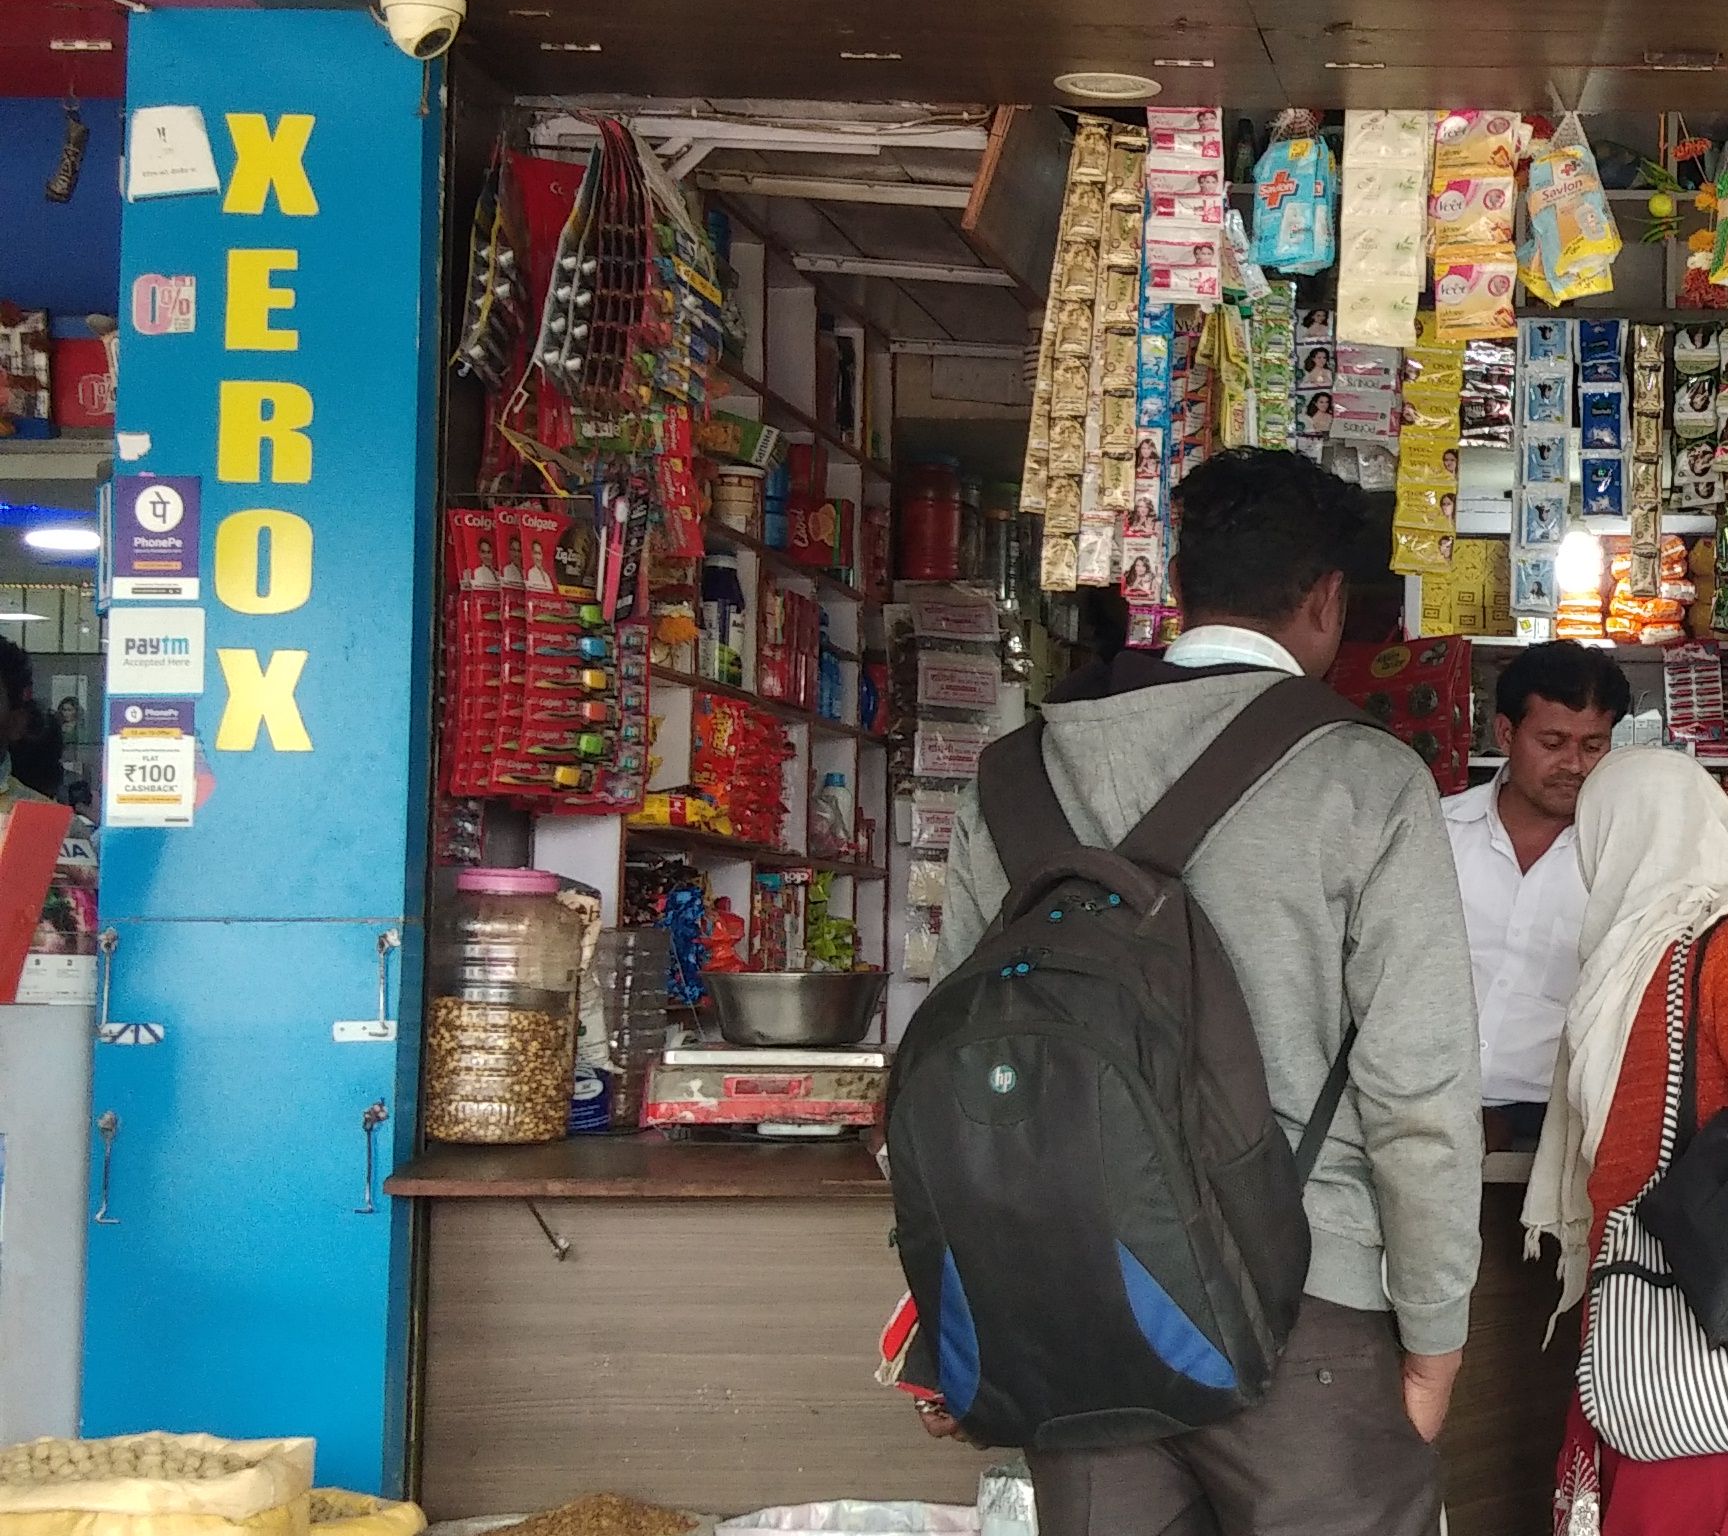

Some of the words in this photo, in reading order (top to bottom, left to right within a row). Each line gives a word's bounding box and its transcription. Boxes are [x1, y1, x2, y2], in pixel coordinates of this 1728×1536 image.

[1541, 177, 1583, 200] Savlon
[214, 113, 319, 752] XEROX
[464, 514, 496, 532] Colg
[522, 514, 558, 532] Colgate
[133, 537, 183, 548] PhonePe
[124, 636, 190, 657] paytm
[123, 658, 163, 667] Accepted
[167, 658, 190, 667] Here
[124, 765, 176, 783] ₹100
[995, 1066, 1012, 1093] hp
